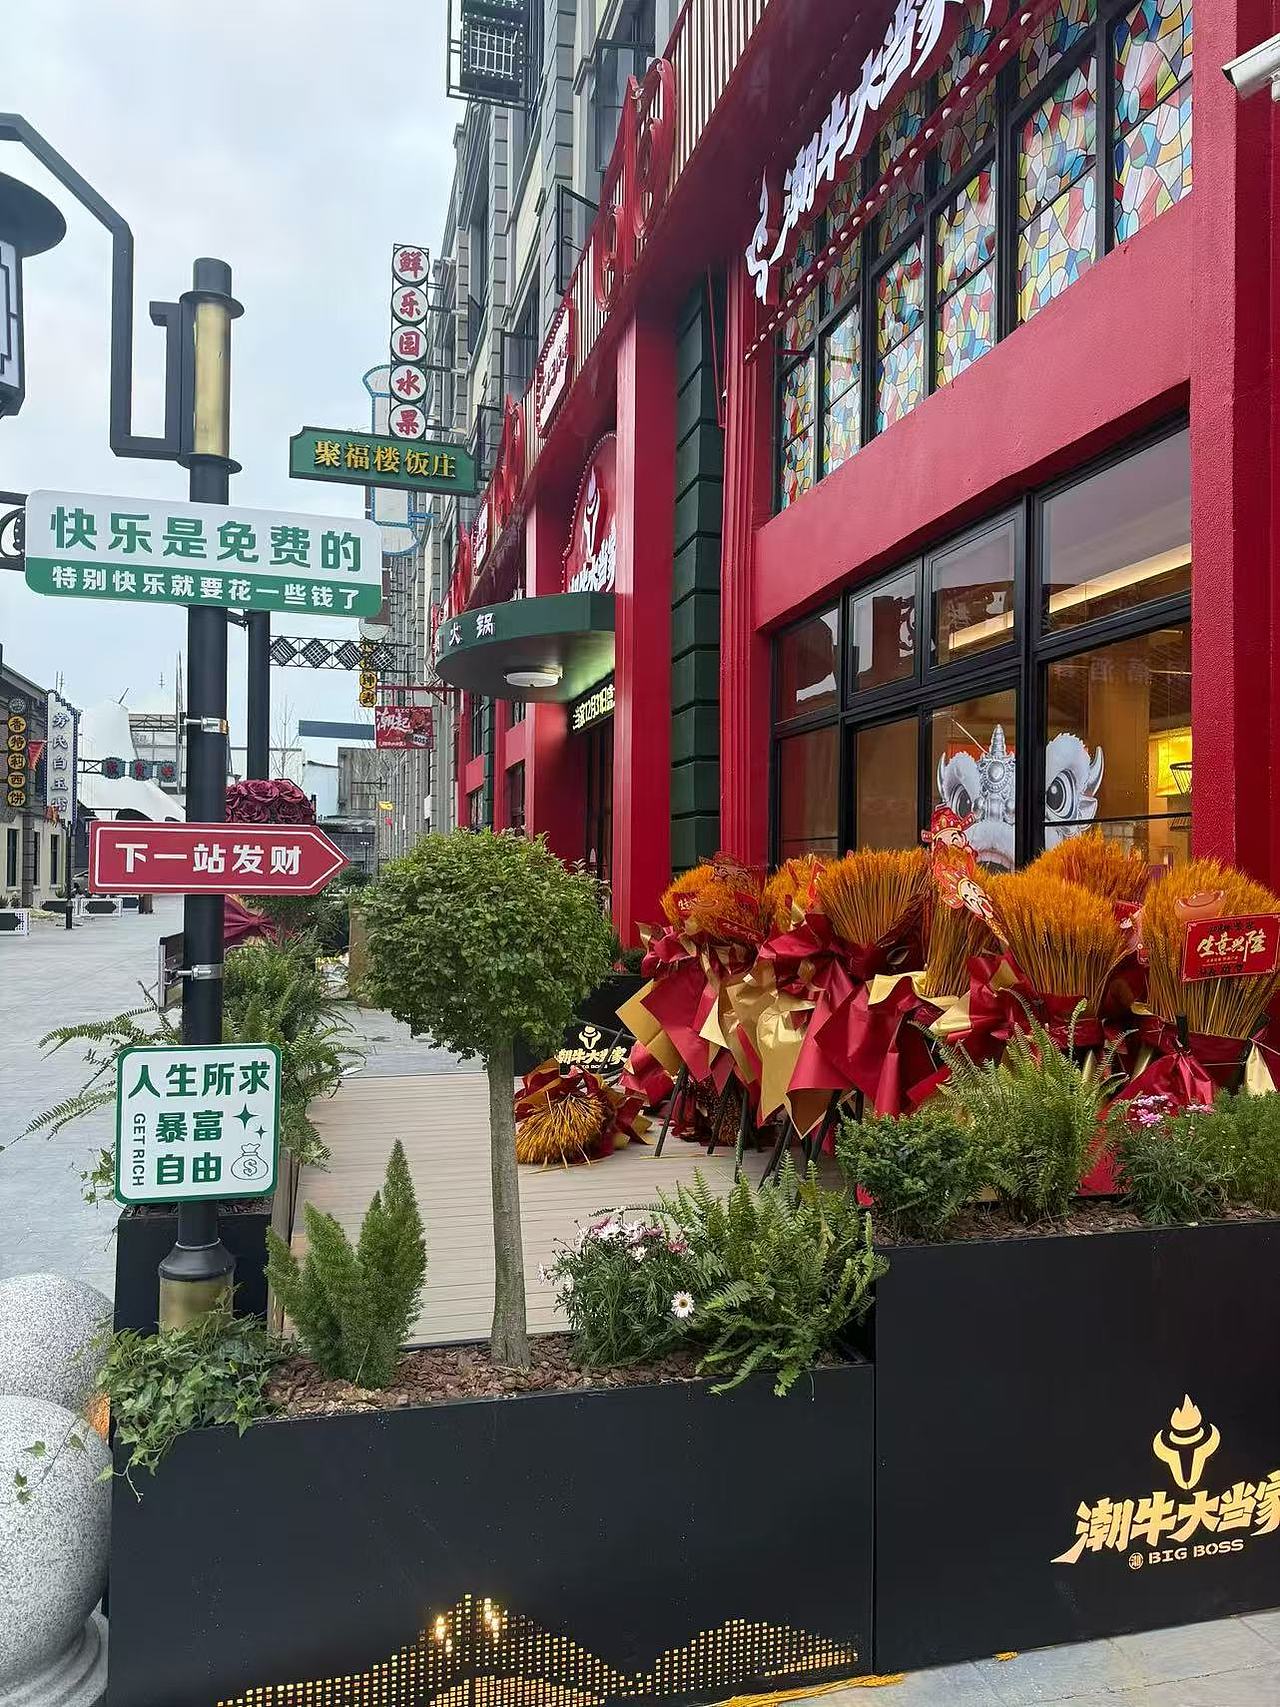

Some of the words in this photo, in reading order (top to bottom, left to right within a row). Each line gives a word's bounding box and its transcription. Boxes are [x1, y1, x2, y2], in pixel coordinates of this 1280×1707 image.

[314, 440, 457, 480] 聚福楼饭庄
[50, 506, 362, 573] 快乐是免费的
[52, 566, 360, 610] 特别快乐就要花一些钱了
[115, 843, 302, 875] 下一站发财
[1197, 928, 1266, 963] 生意兴隆
[128, 1060, 271, 1099] 人生所求
[133, 1113, 146, 1145] GET
[155, 1110, 224, 1143] 暴富
[132, 1149, 145, 1186] RICH
[156, 1152, 223, 1185] 自由
[1148, 1547, 1188, 1564] BIG
[1193, 1539, 1244, 1557] BOSS
